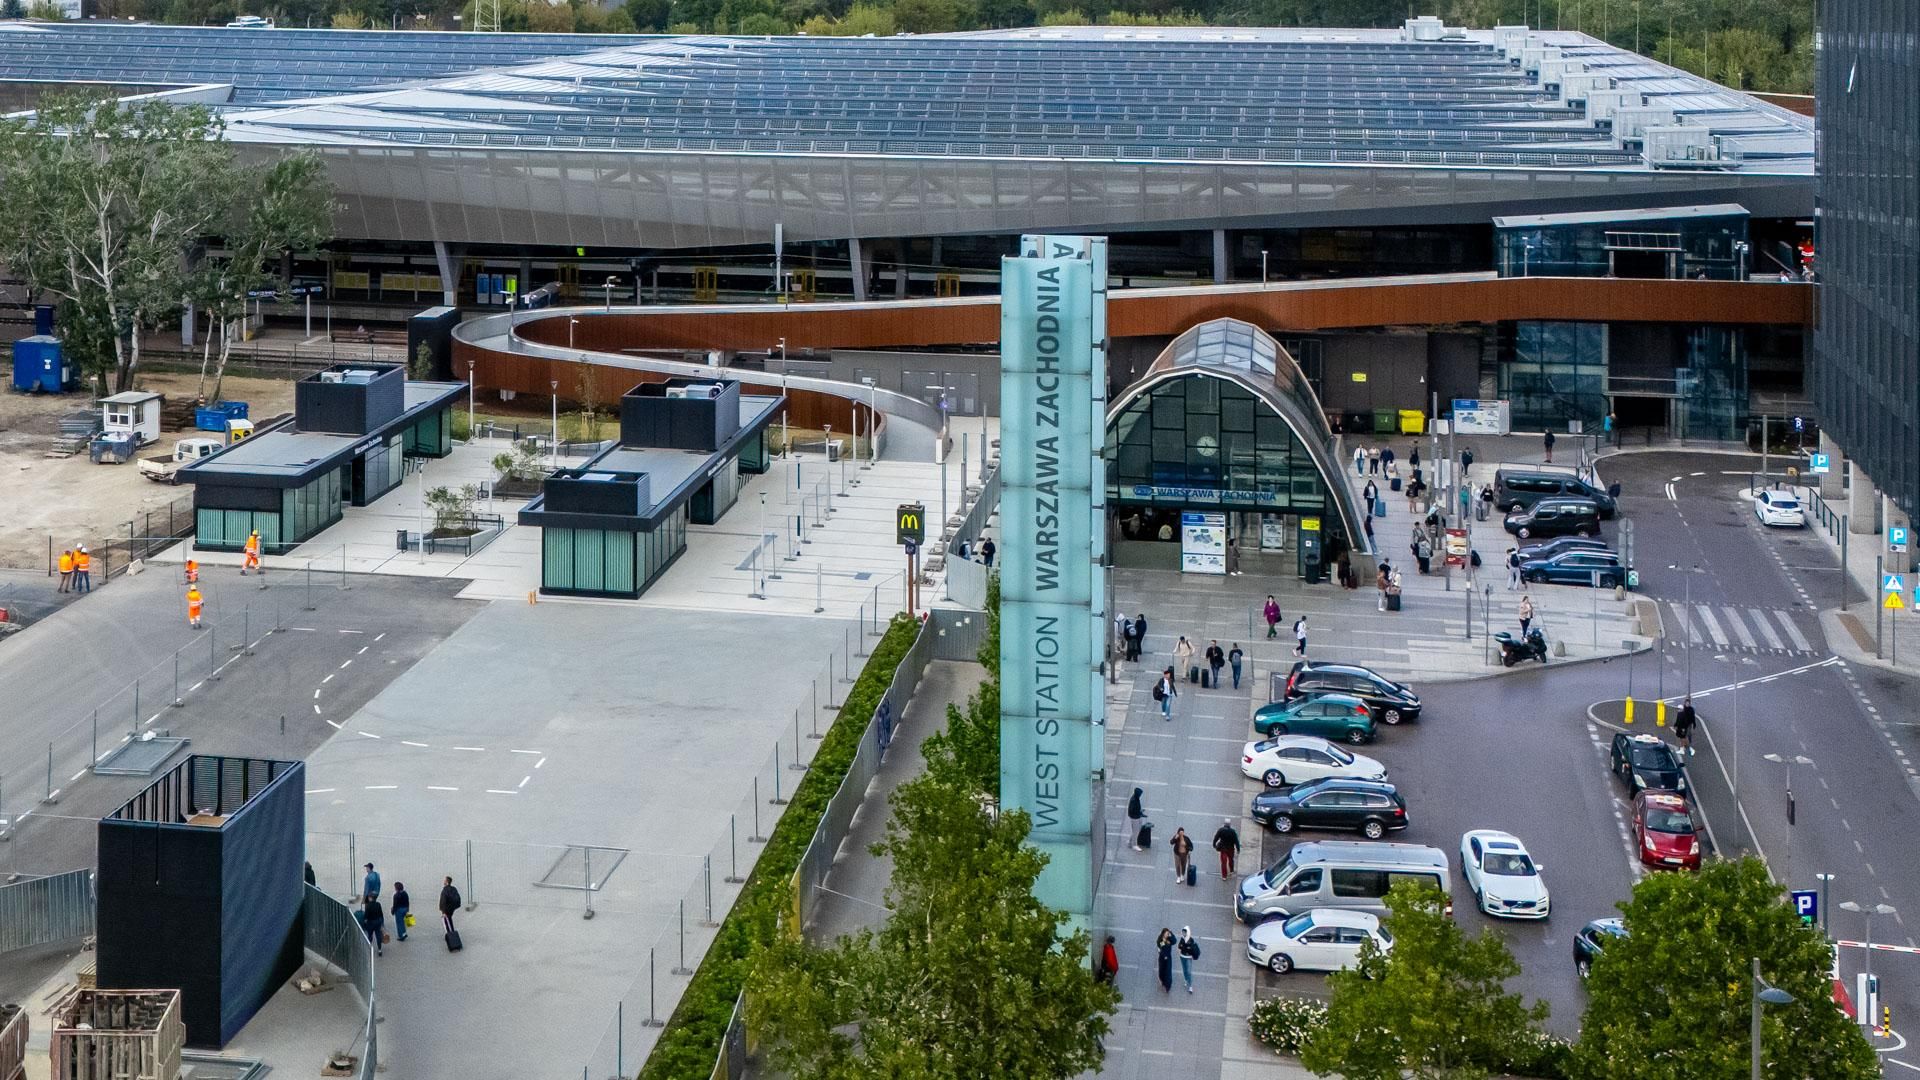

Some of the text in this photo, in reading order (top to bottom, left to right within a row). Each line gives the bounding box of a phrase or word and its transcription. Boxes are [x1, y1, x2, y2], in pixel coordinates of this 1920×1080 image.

[1036, 266, 1060, 590] WARSZAWA ZACHODNIA
[1817, 455, 1826, 465] P
[1157, 486, 1214, 498] WARSZAWA
[1219, 489, 1276, 501] ZACHODNIA
[1893, 529, 1903, 541] P
[1036, 616, 1060, 828] WEST STATION
[1798, 896, 1812, 914] P
